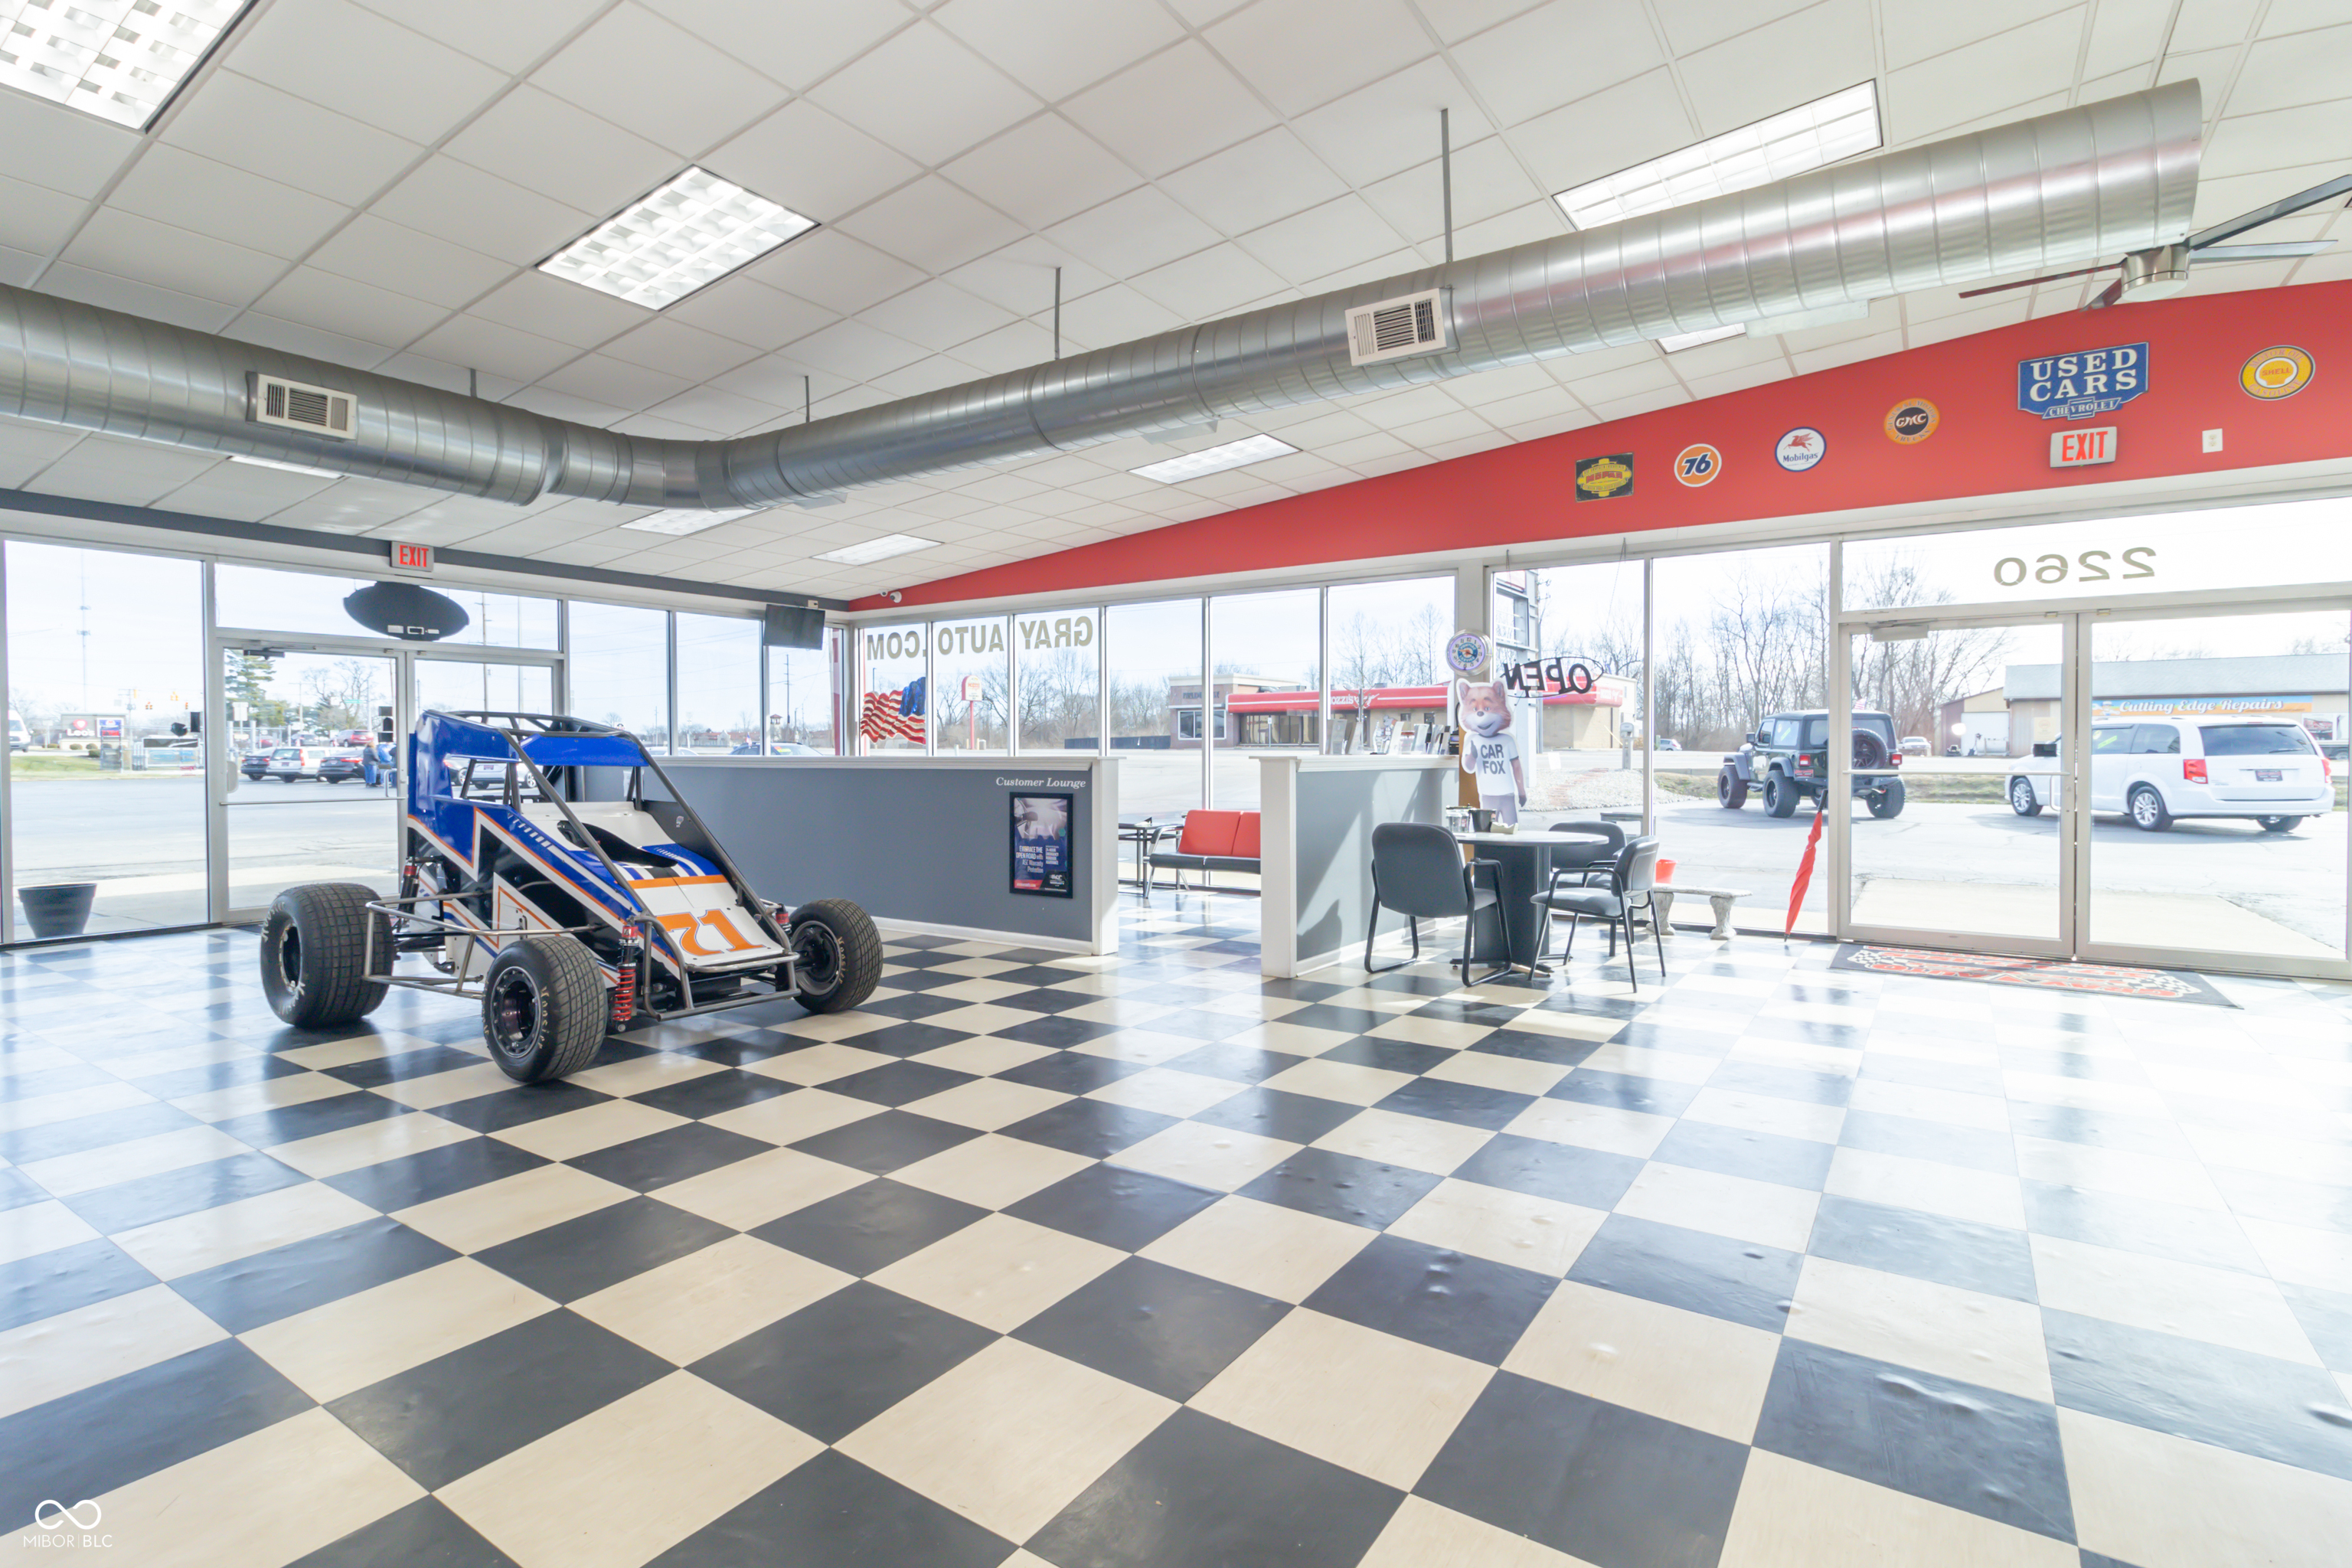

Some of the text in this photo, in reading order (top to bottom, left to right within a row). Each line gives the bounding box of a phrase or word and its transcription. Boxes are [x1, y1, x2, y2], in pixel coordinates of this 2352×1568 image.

[2030, 348, 2138, 381] USED
[2249, 349, 2305, 368] MOTOR OIL
[2262, 368, 2291, 376] SHELL
[2030, 369, 2137, 401] CARS
[2249, 379, 2303, 397] GASOLINE
[2049, 400, 2115, 416] CHEVROLET
[1896, 413, 1926, 428] GMC
[2062, 430, 2109, 462] EXIT
[1682, 452, 1713, 477] 76
[1782, 452, 1818, 463] Mobilgas
[1586, 471, 1623, 484] MOPAR
[399, 544, 429, 568] EXIT
[1331, 694, 1354, 705] OZZI'S
[2119, 698, 2283, 714] Cutting Edge Repairs
[1481, 743, 1504, 760] CAR
[1483, 760, 1506, 775] FOX
[996, 777, 1086, 789] Customer Lounge
[655, 908, 766, 957] 71
[1870, 962, 2179, 997] GRAY AUTO
